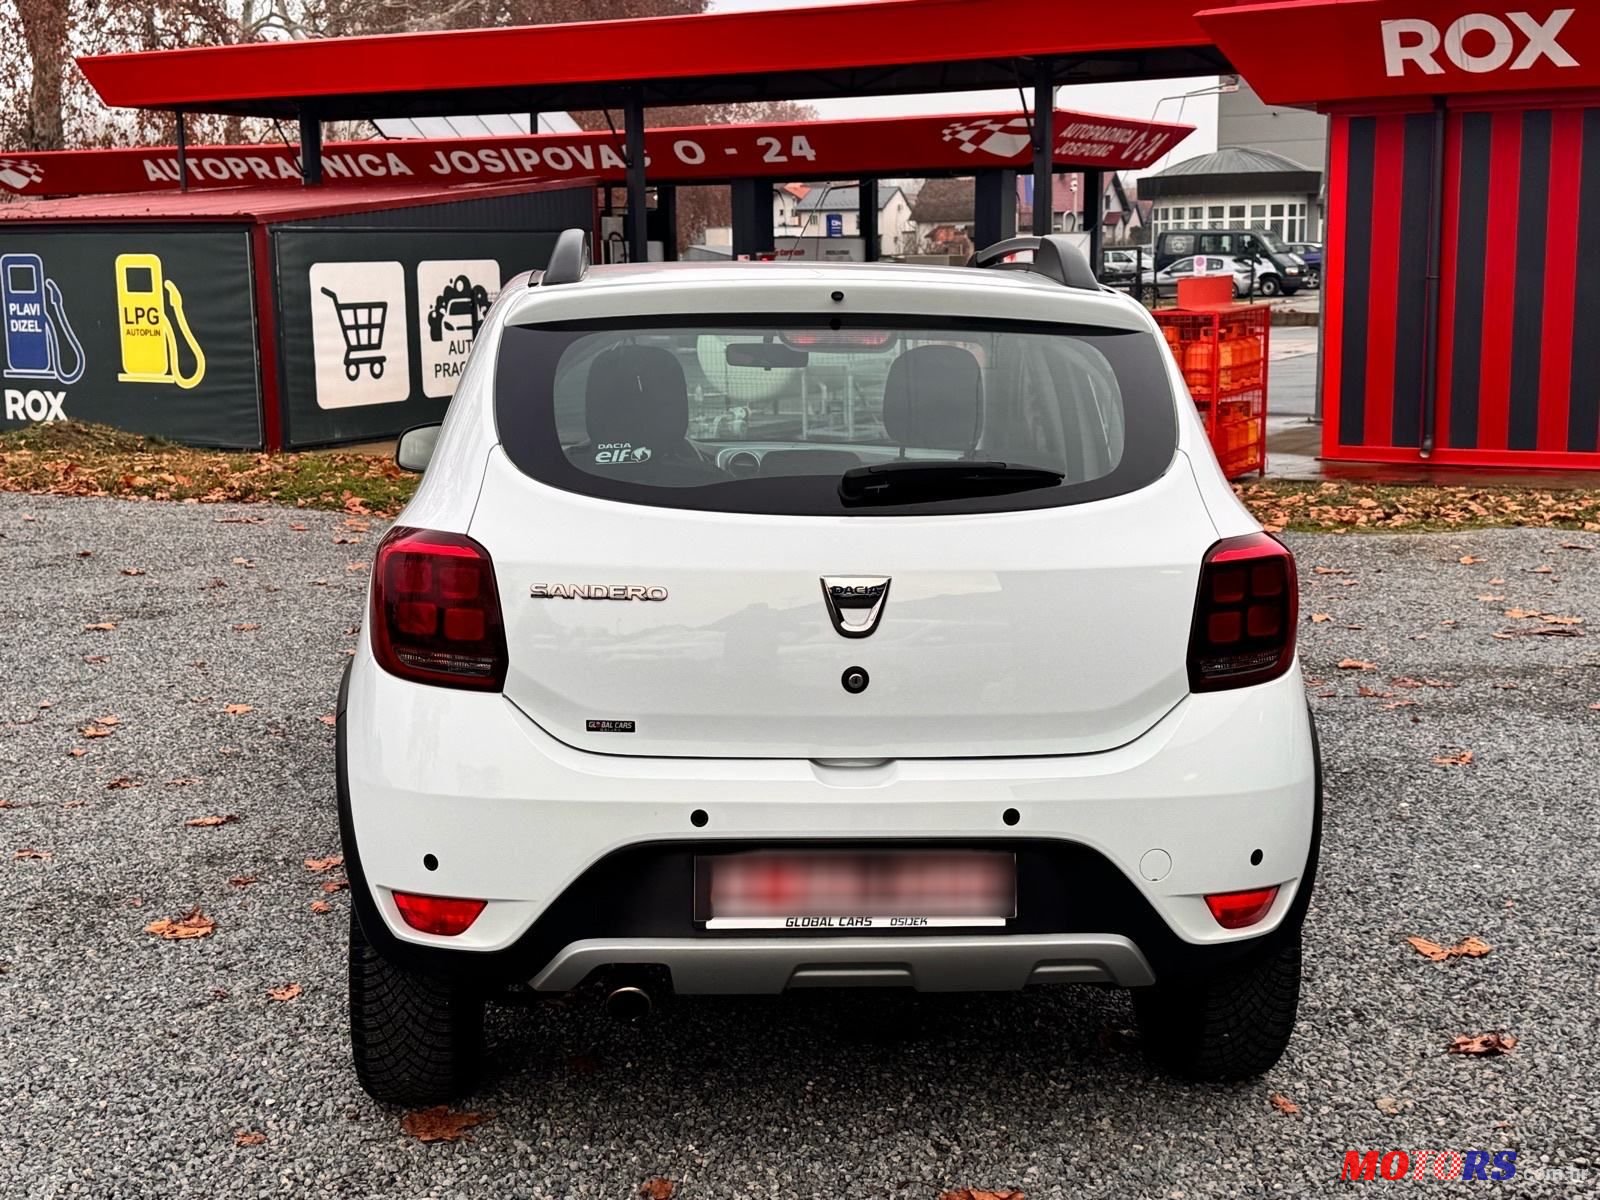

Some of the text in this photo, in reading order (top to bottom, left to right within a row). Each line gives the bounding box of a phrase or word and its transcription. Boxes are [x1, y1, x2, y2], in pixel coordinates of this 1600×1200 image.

[1381, 9, 1580, 77] ROX
[142, 152, 414, 182] AUTOPRANICA
[756, 135, 816, 163] 24
[9, 303, 41, 316] PLAVI
[124, 307, 160, 325] LPG
[10, 320, 42, 332] DIZEL
[126, 329, 161, 337] AUTOPLIN
[449, 339, 473, 355] AUT
[4, 389, 68, 422] ROX
[595, 449, 631, 463] elf
[530, 583, 668, 601] SANDERO
[834, 586, 878, 594] DACIA
[785, 917, 928, 927] GLOBAL CARS OSIJEK
